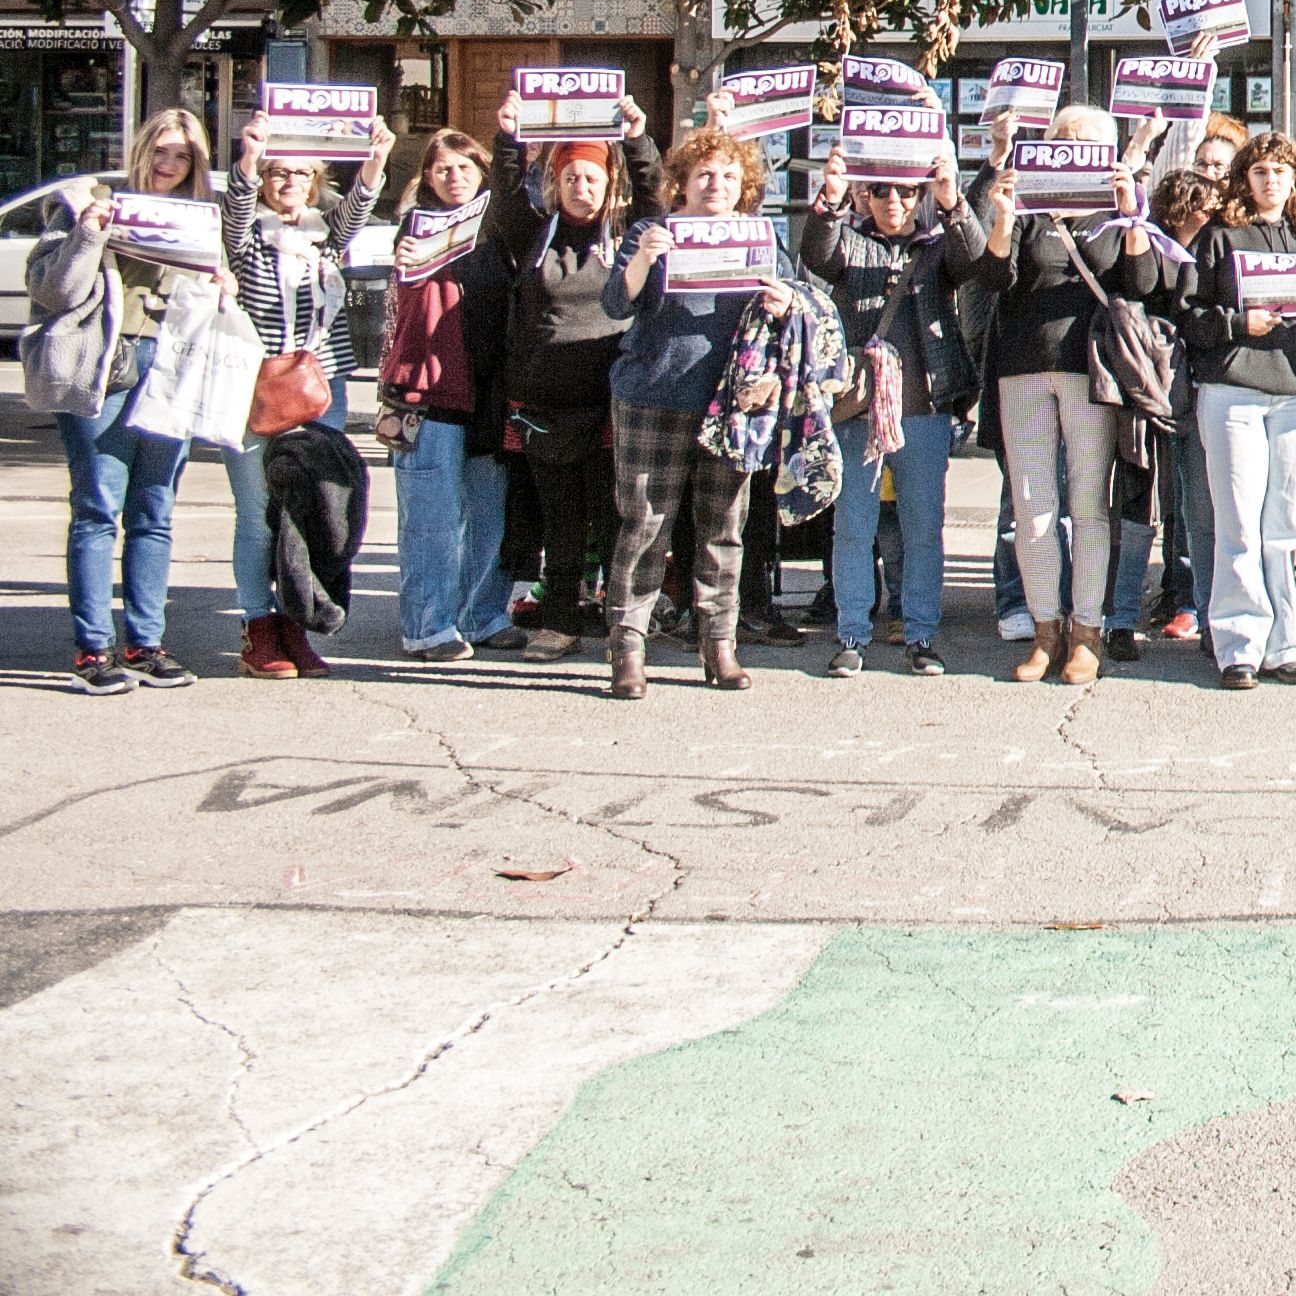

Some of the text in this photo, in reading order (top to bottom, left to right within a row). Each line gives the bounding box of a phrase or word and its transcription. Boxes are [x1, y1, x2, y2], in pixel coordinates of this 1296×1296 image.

[525, 72, 617, 95] PROU!!
[274, 89, 368, 112] PROU!!
[850, 111, 939, 133] PROU!!
[1020, 145, 1110, 167] PROU!!
[675, 221, 768, 244] PROU!!
